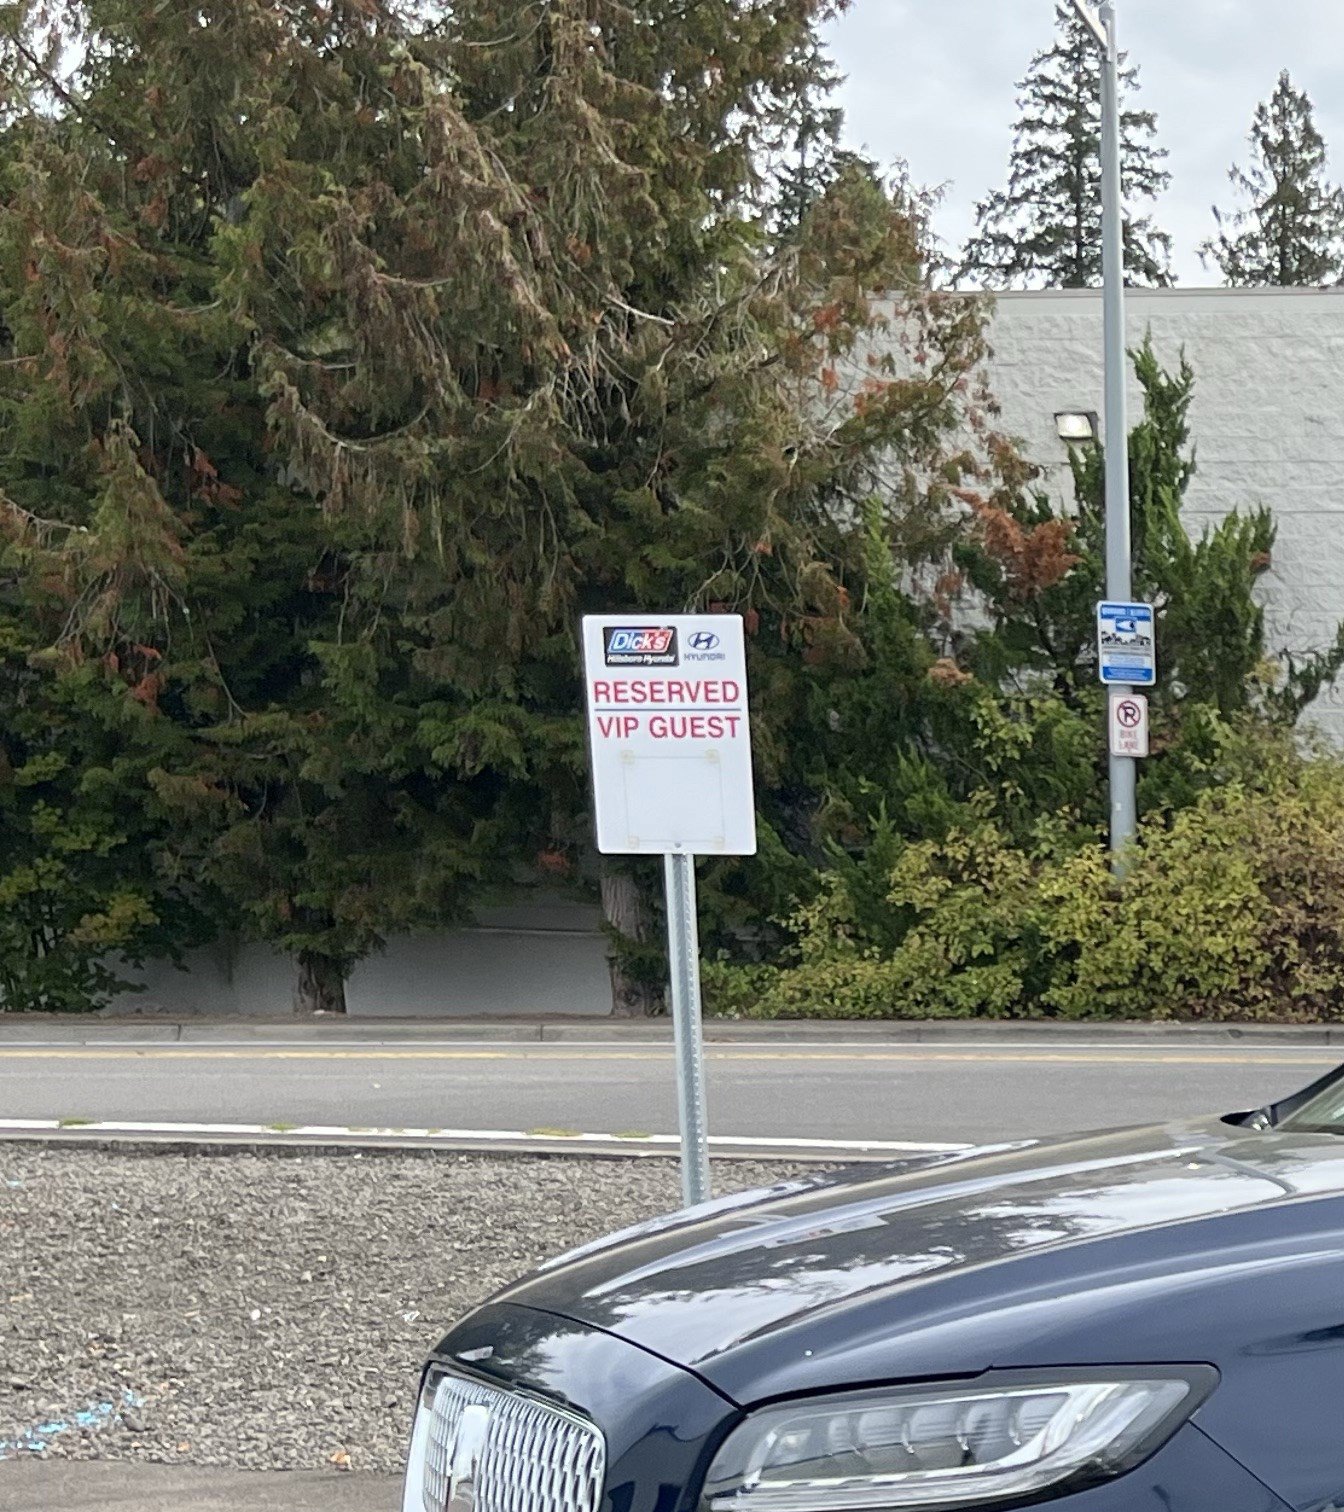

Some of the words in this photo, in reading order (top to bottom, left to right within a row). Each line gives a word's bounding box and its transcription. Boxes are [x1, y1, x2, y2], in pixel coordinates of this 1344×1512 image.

[594, 681, 740, 704] RESERVED
[597, 716, 639, 739] VIP
[649, 716, 741, 739] GUEST
